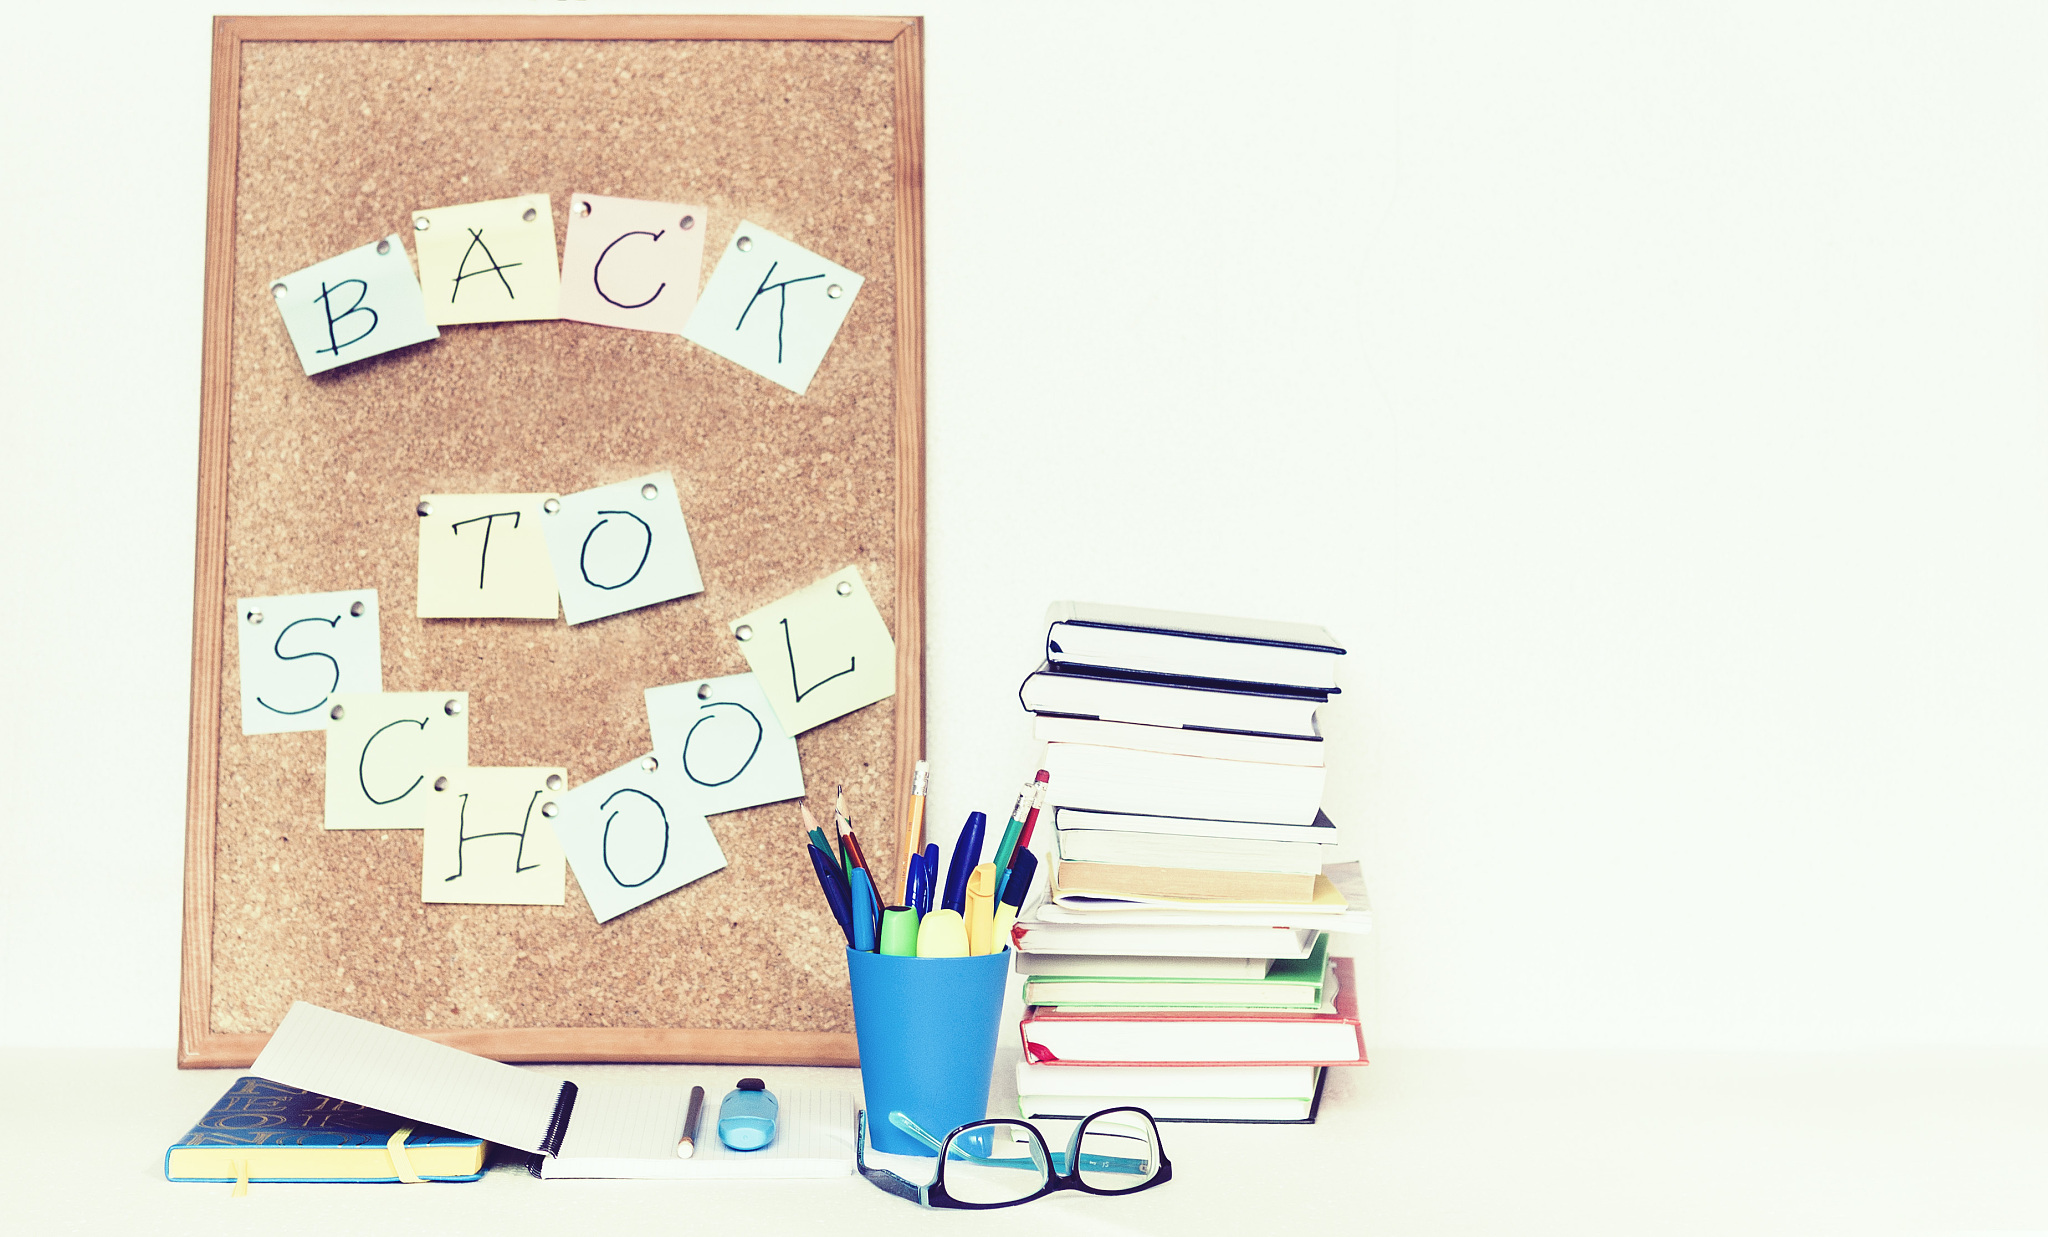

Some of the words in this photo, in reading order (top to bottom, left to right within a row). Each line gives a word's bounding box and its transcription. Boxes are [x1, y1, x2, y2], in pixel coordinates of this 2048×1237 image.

[314, 228, 826, 363] BACK
[452, 510, 652, 590] TO
[256, 614, 855, 888] SCHOOL
